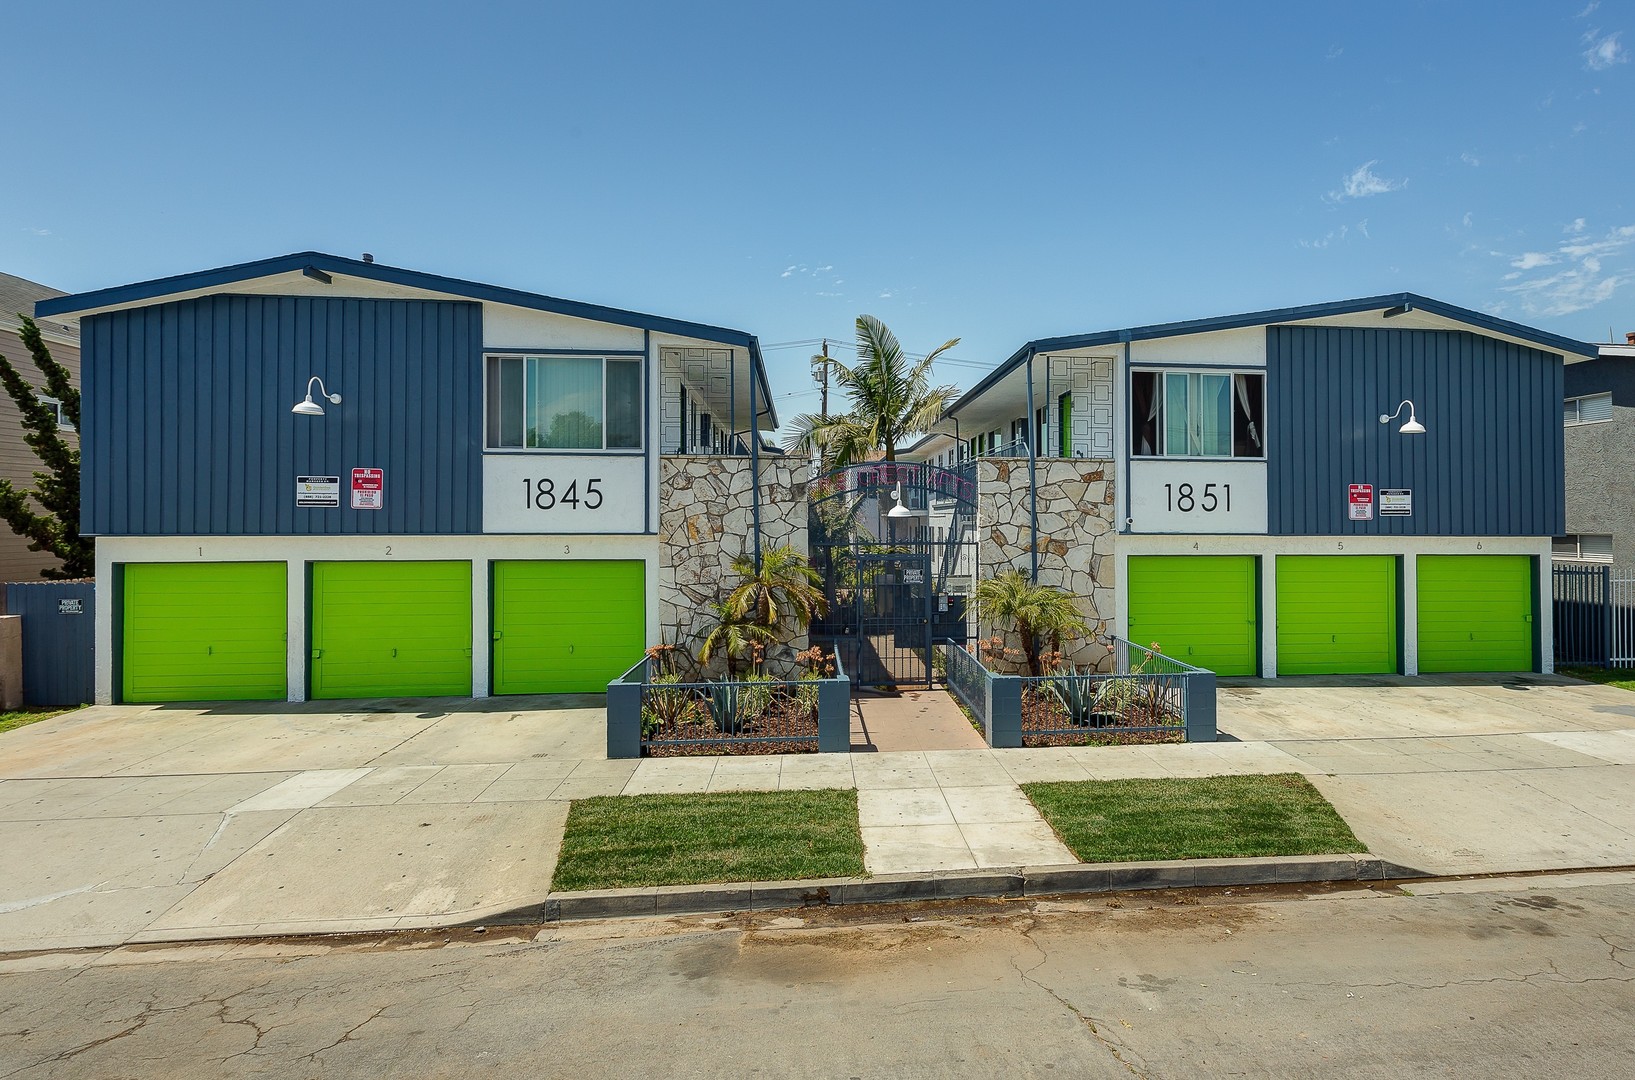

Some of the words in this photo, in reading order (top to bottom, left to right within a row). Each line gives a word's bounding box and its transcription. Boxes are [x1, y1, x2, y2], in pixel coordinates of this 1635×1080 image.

[522, 478, 603, 510] 1845
[1164, 482, 1231, 512] 1851
[385, 545, 393, 556] 2
[563, 544, 570, 555] 3
[1192, 542, 1200, 551] 4
[1337, 541, 1344, 551] 5
[1476, 541, 1483, 550] 6
[198, 546, 203, 557] 1
